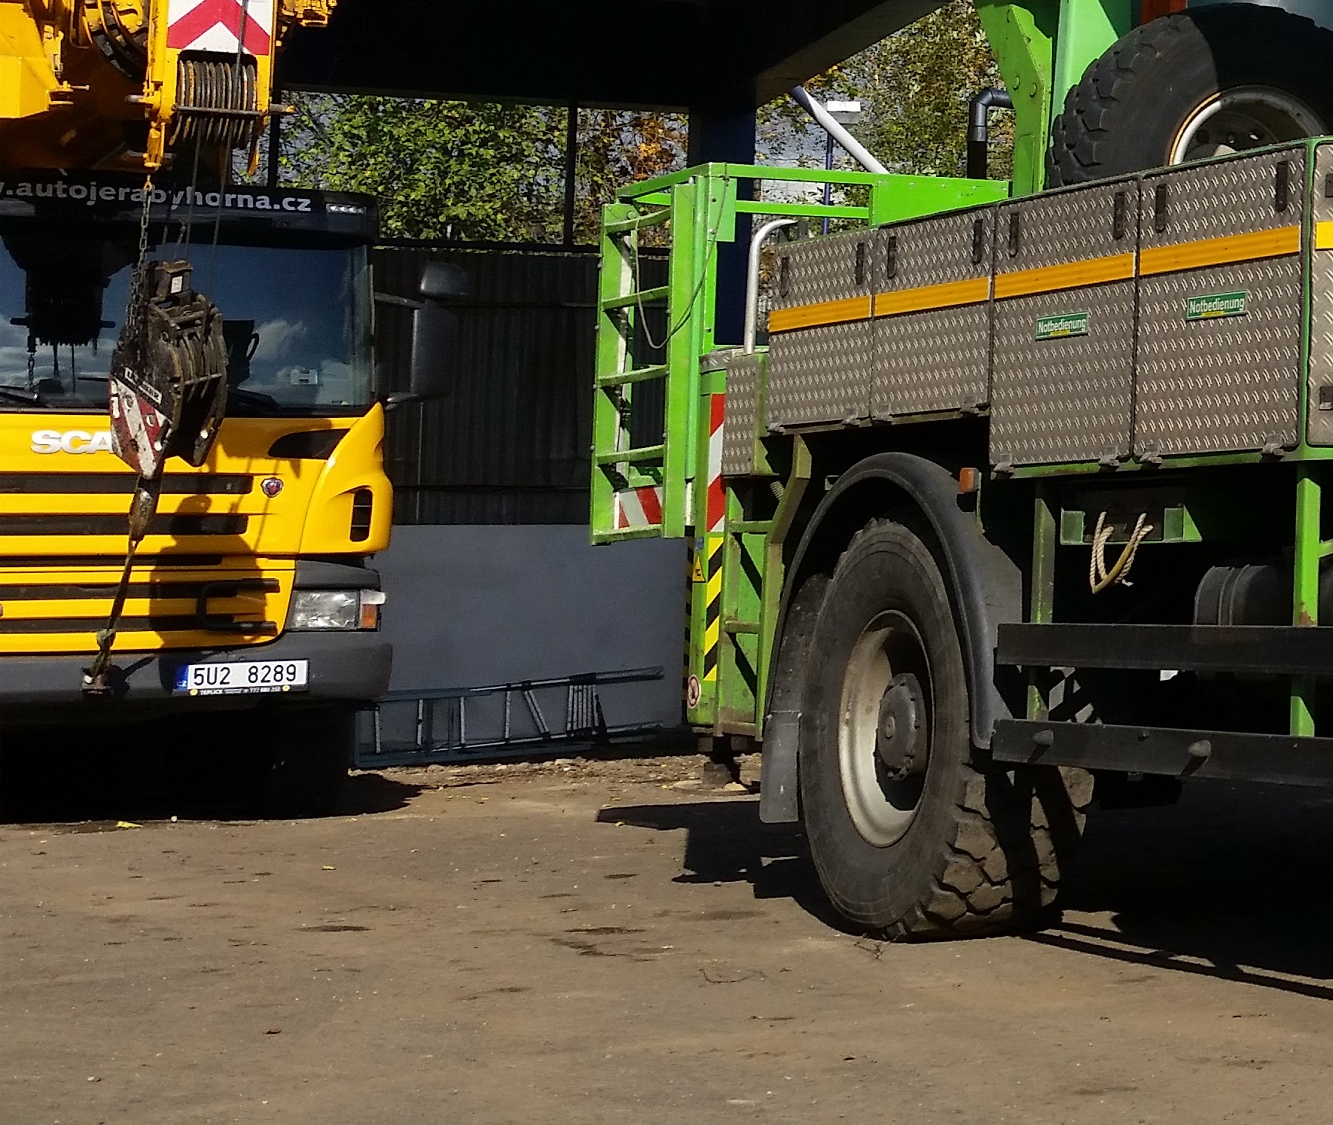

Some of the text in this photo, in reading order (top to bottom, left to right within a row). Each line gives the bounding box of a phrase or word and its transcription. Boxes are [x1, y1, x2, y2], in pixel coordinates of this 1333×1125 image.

[0, 180, 312, 212] .autojerabyhorna.cz
[1189, 295, 1245, 314] Notbedienung
[1038, 318, 1086, 333] Notbedienung
[194, 664, 296, 686] 5U2 8289
